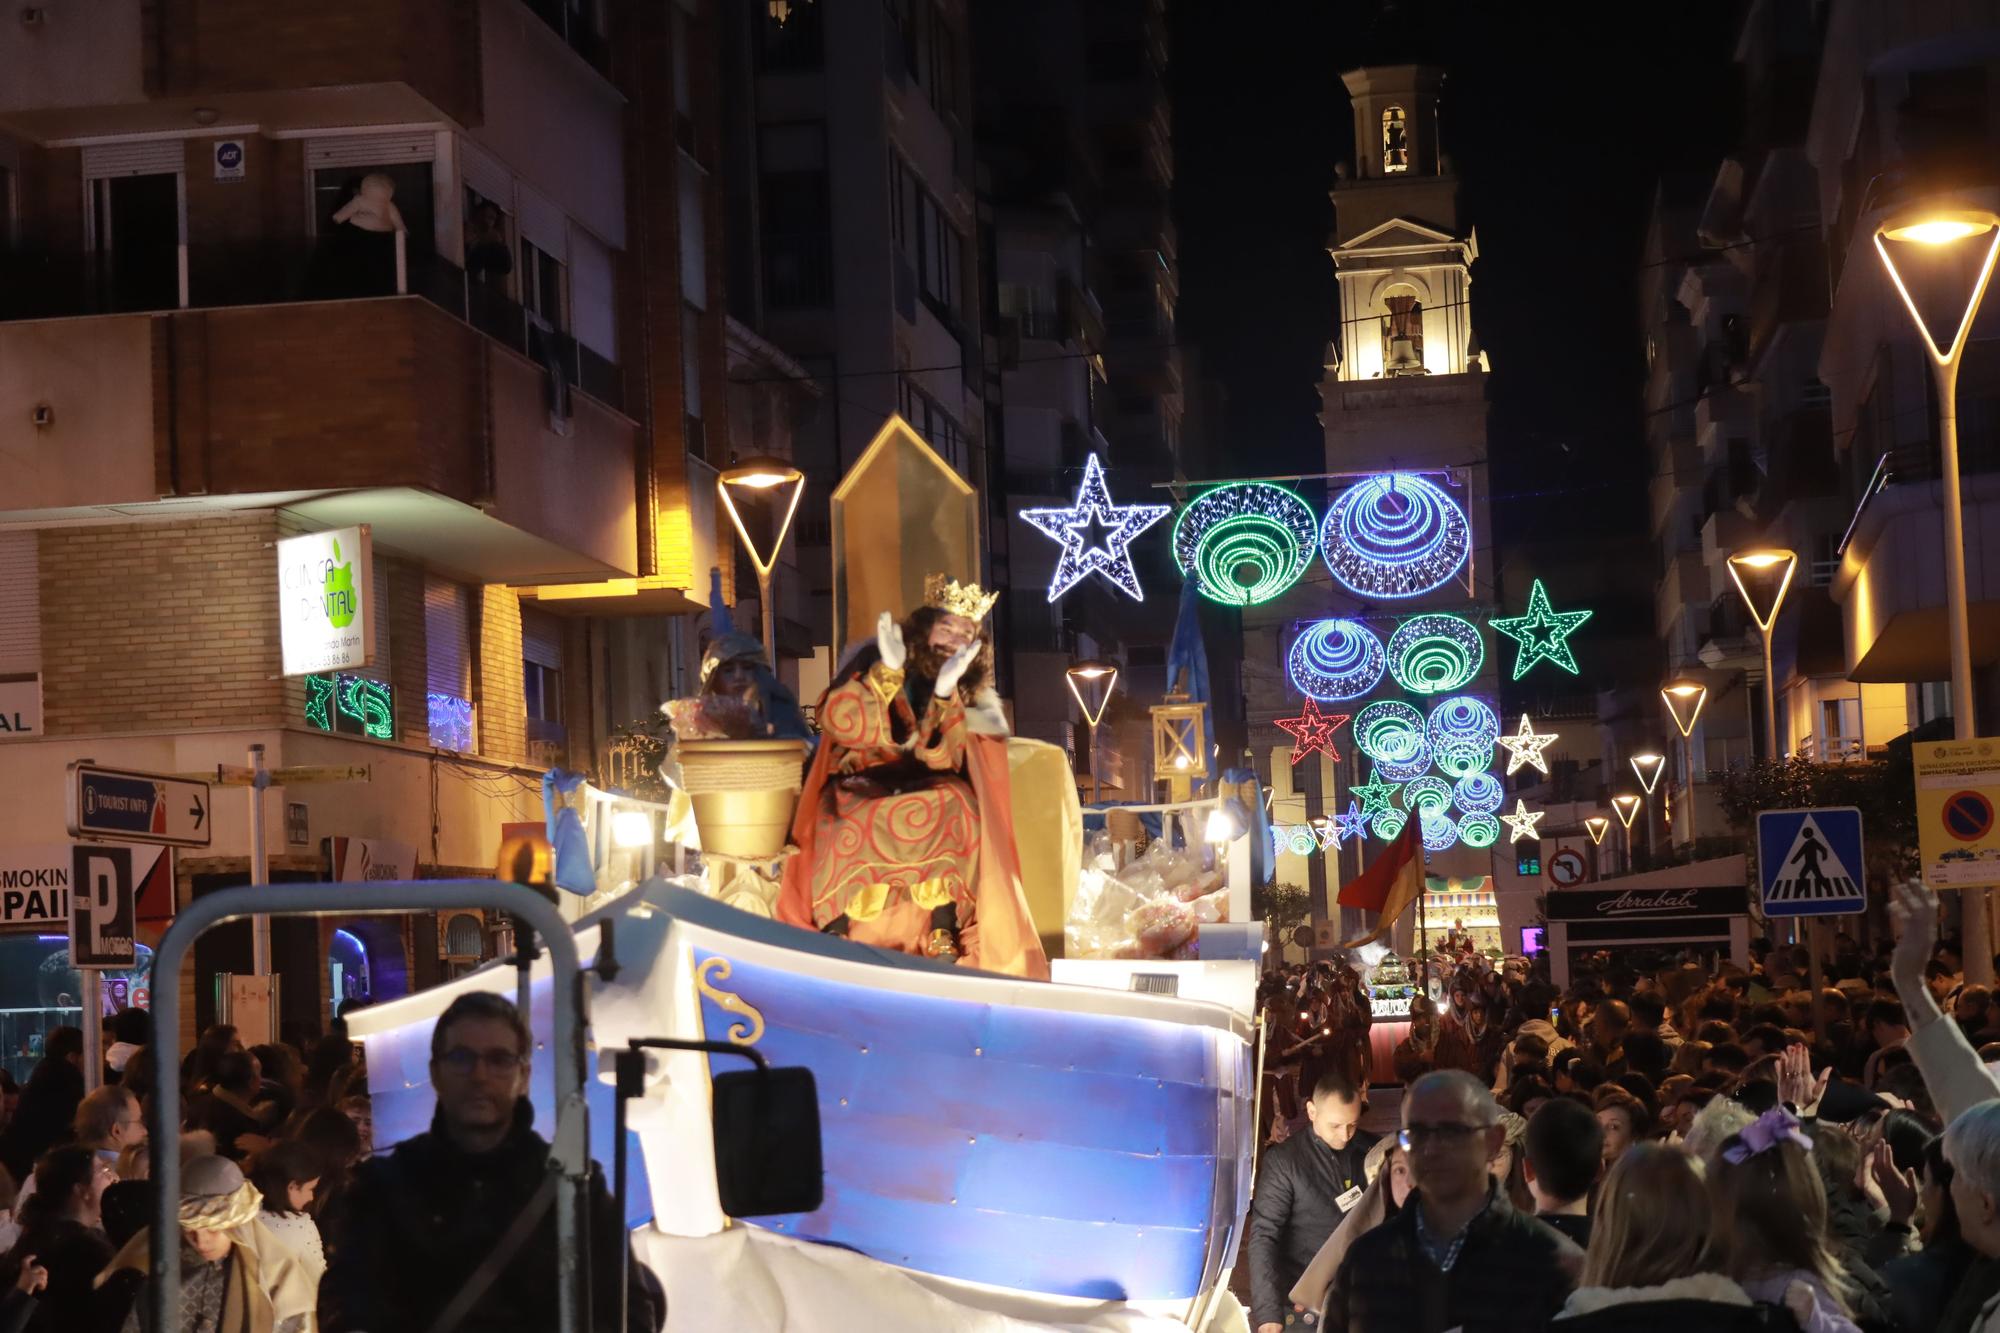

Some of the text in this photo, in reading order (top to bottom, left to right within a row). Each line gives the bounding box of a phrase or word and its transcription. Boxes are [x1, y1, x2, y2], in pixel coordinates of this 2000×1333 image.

[221, 151, 239, 161] ADT
[98, 794, 148, 814] TOURIST INFO
[0, 868, 68, 888] MOKIN
[0, 888, 68, 920] PAI
[89, 856, 118, 955] P
